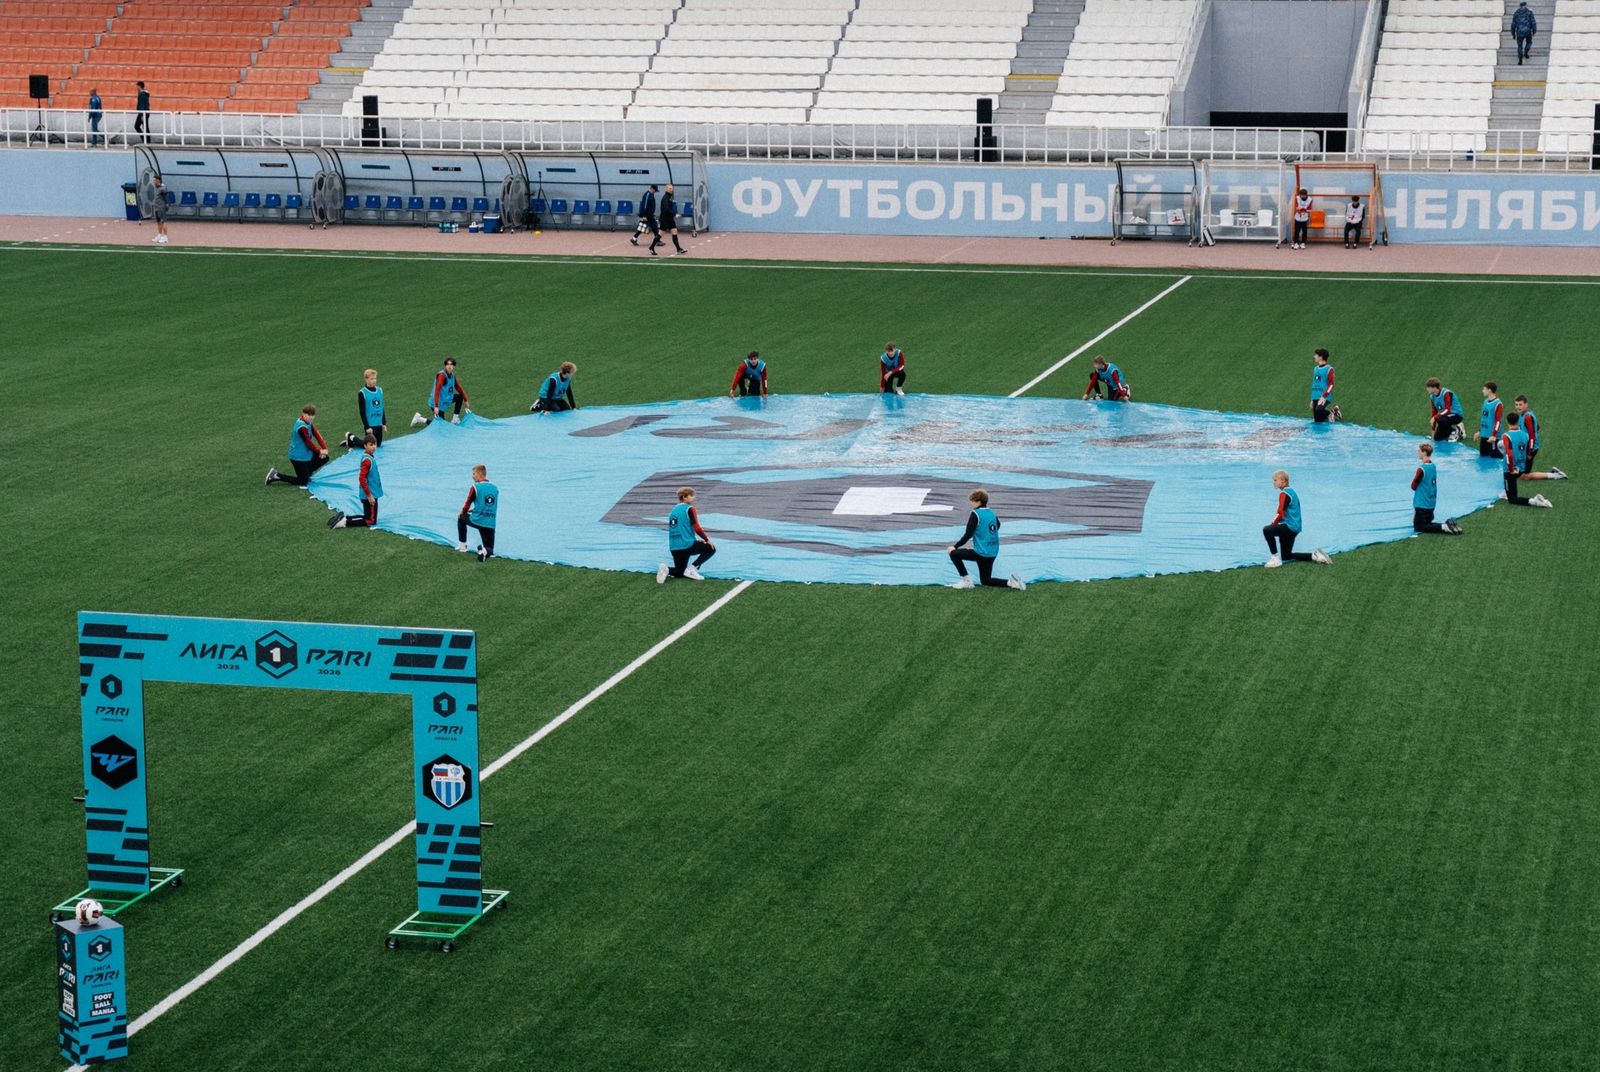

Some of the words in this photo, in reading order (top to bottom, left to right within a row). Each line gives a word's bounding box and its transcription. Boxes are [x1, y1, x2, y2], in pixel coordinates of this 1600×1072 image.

[731, 174, 1162, 224] ФУТБОЛЬНЫЙ
[179, 642, 248, 661] ЛИГА
[269, 647, 282, 663] 1
[305, 648, 372, 667] PARI
[217, 663, 241, 671] 2025
[317, 668, 342, 676] 2026
[106, 681, 115, 693] 1
[440, 699, 448, 711] 1
[95, 706, 129, 716] PARI
[428, 724, 463, 735] PARI
[83, 970, 120, 984] PARI
[94, 993, 112, 1001] FOOT
[94, 1000, 111, 1009] BALL
[91, 1007, 115, 1016] MANIA
